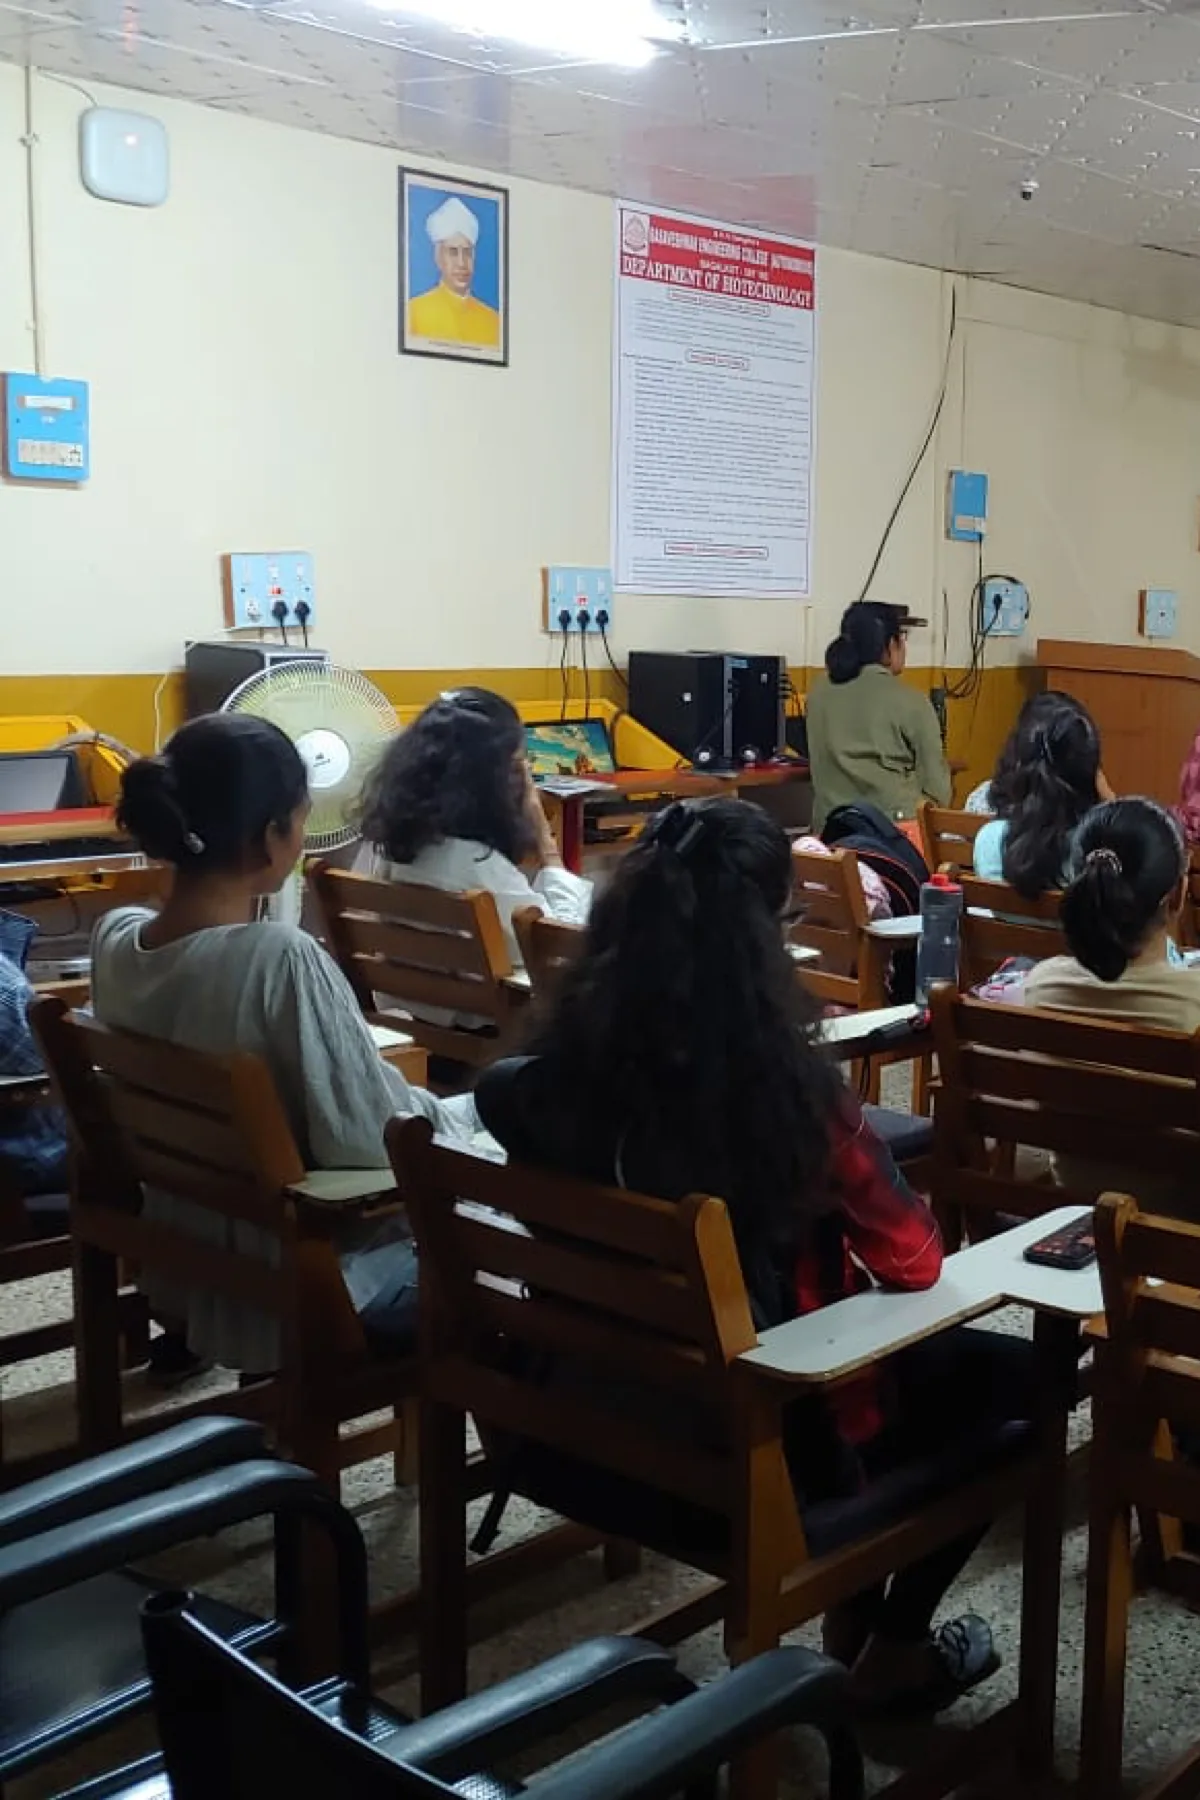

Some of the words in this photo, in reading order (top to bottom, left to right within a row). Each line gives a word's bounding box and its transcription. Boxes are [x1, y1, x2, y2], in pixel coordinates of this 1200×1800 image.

[622, 255, 702, 288] DEPARTMENT
[704, 271, 720, 290] OF
[722, 275, 812, 309] BIOTECHNOLOGY
